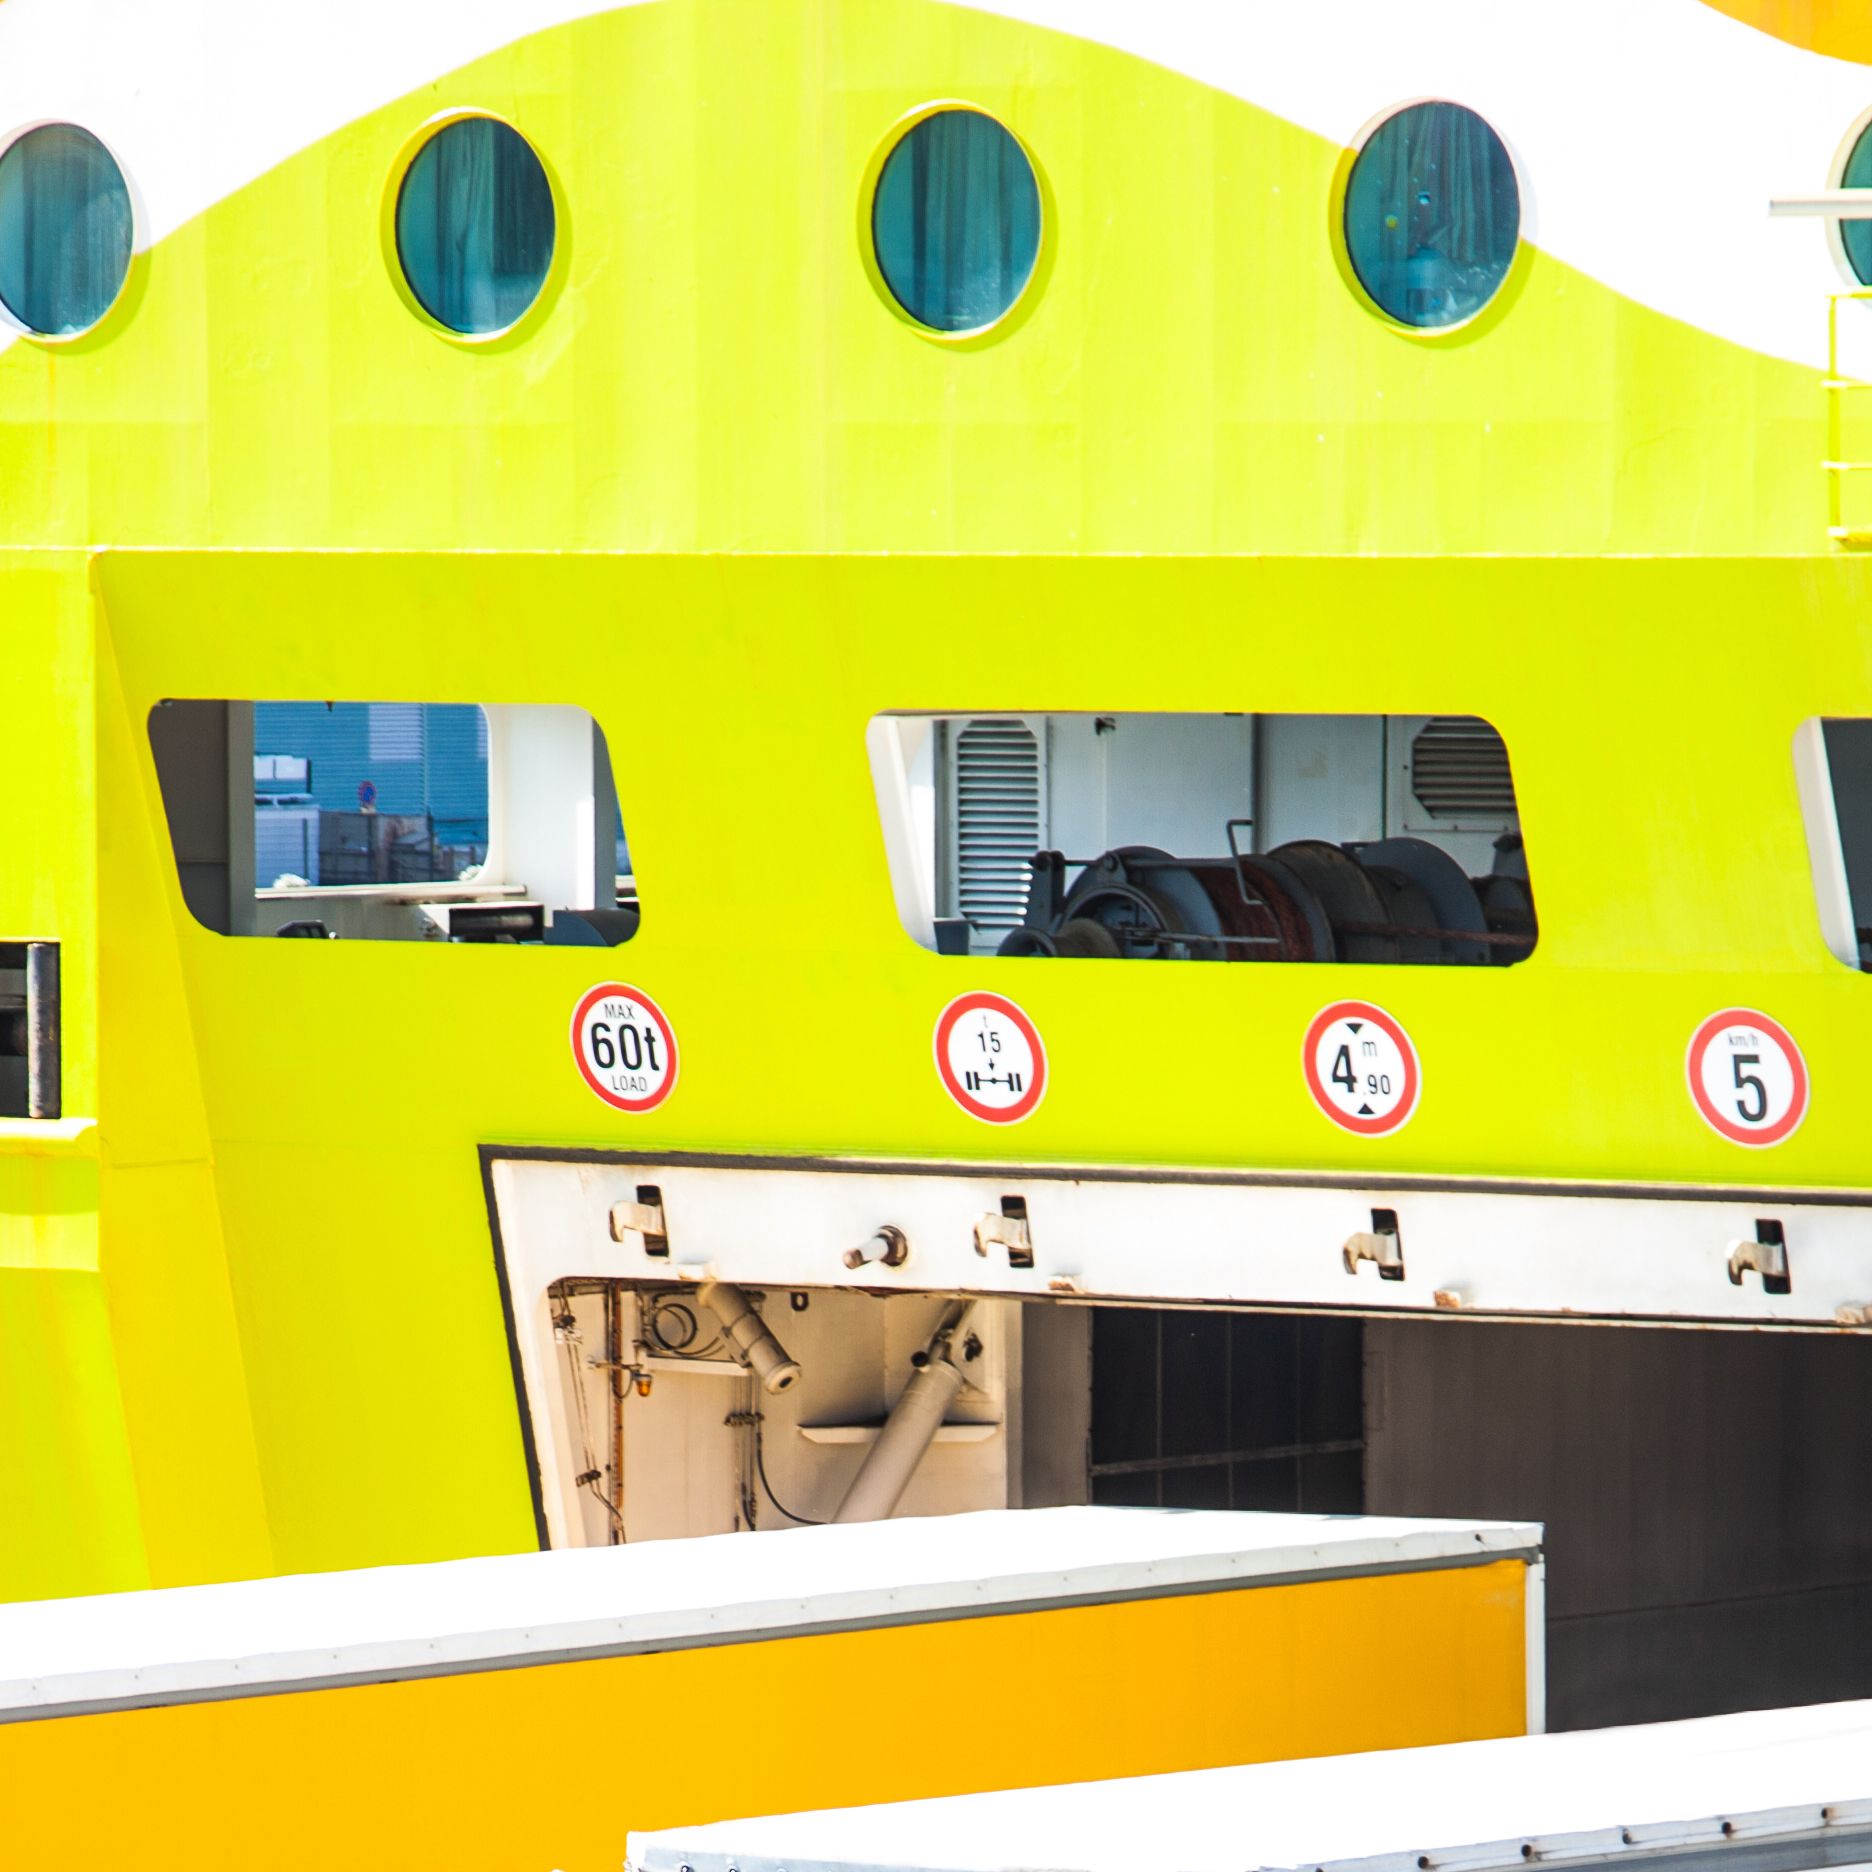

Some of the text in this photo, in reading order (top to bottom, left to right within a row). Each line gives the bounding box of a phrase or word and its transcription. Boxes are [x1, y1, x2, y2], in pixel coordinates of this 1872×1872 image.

[604, 1003, 636, 1021] MAX
[590, 1022, 660, 1072] 60t
[977, 1031, 1002, 1054] 15
[1728, 1032, 1759, 1047] km/h
[611, 1074, 648, 1092] LOAD
[1733, 1054, 1767, 1122] 5
